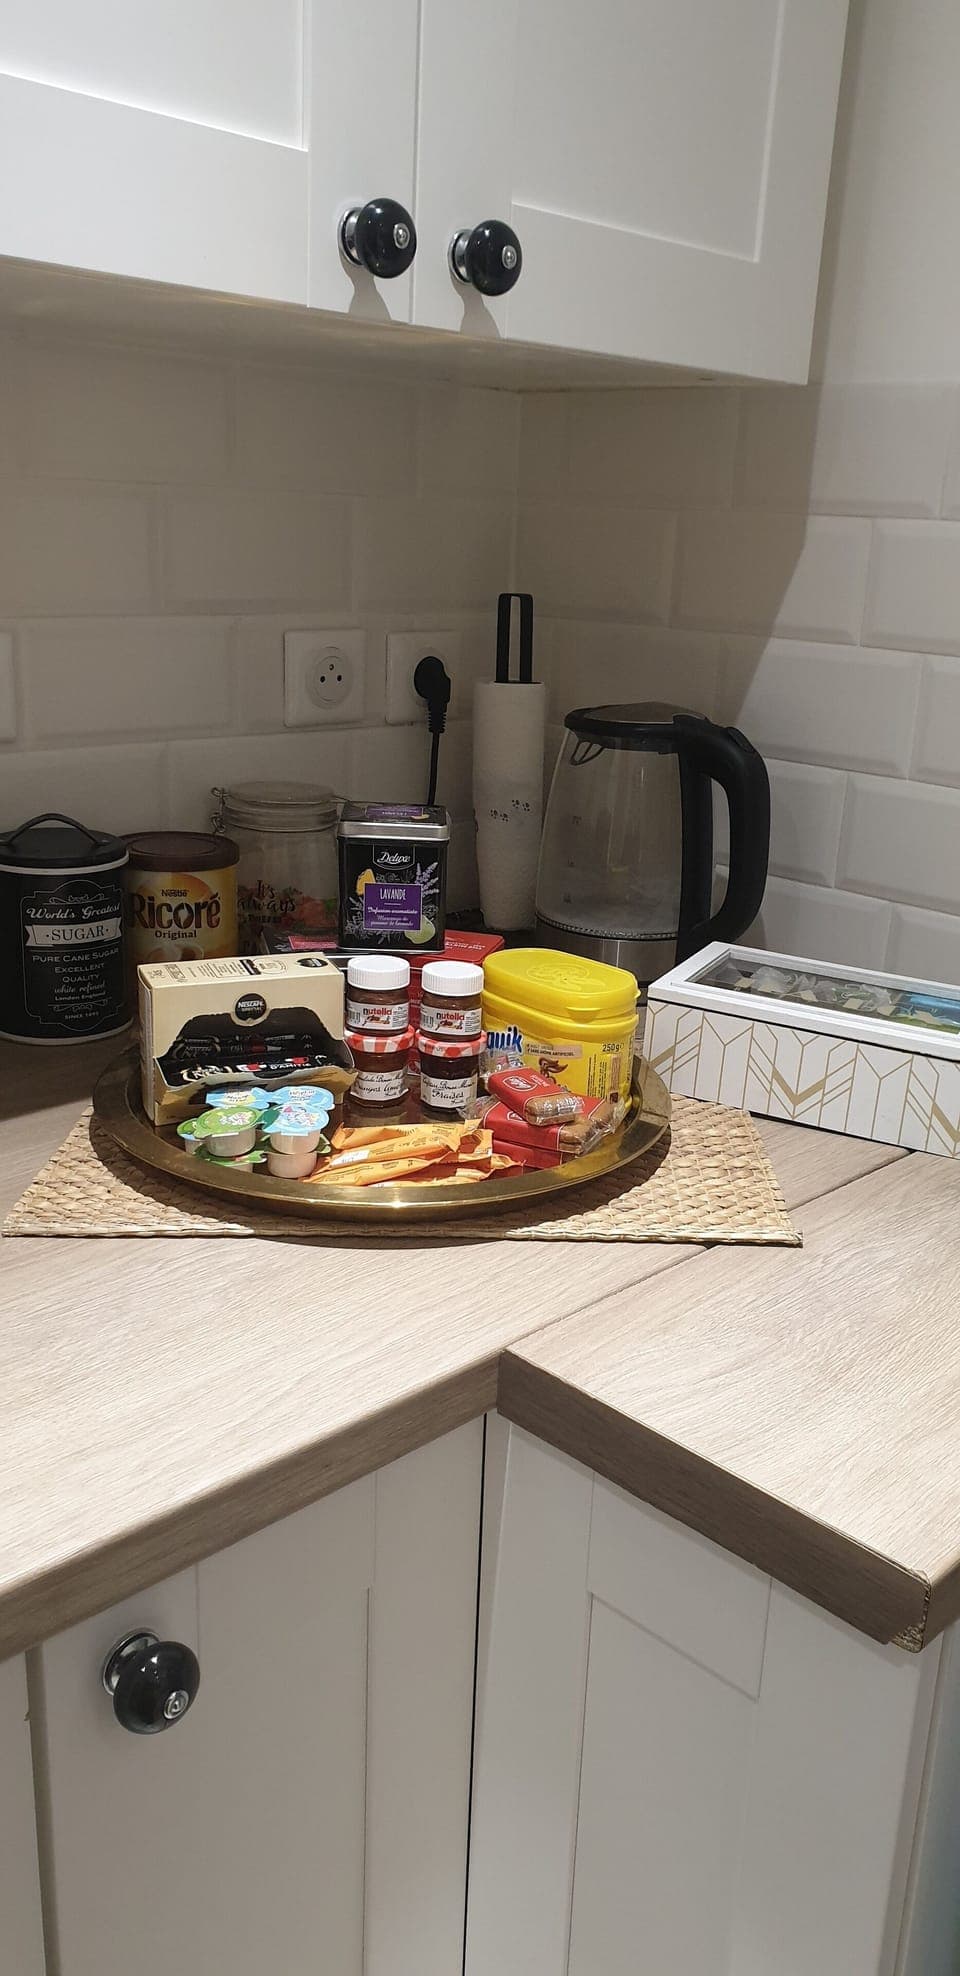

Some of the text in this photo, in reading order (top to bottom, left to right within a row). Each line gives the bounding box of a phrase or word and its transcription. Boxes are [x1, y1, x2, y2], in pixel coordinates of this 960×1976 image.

[377, 852, 411, 865] Deluxe
[380, 888, 407, 900] LAVANDE
[26, 902, 121, 920] World's Greatest
[129, 892, 221, 930] Ricoré
[154, 930, 197, 940] Original
[32, 947, 119, 963] PURE CANE SUGAR
[54, 962, 105, 974] EXCELLENT
[62, 974, 100, 983] QUALITY
[363, 1007, 392, 1016] nutella
[436, 1012, 464, 1021] nutella
[487, 1026, 522, 1056] quik
